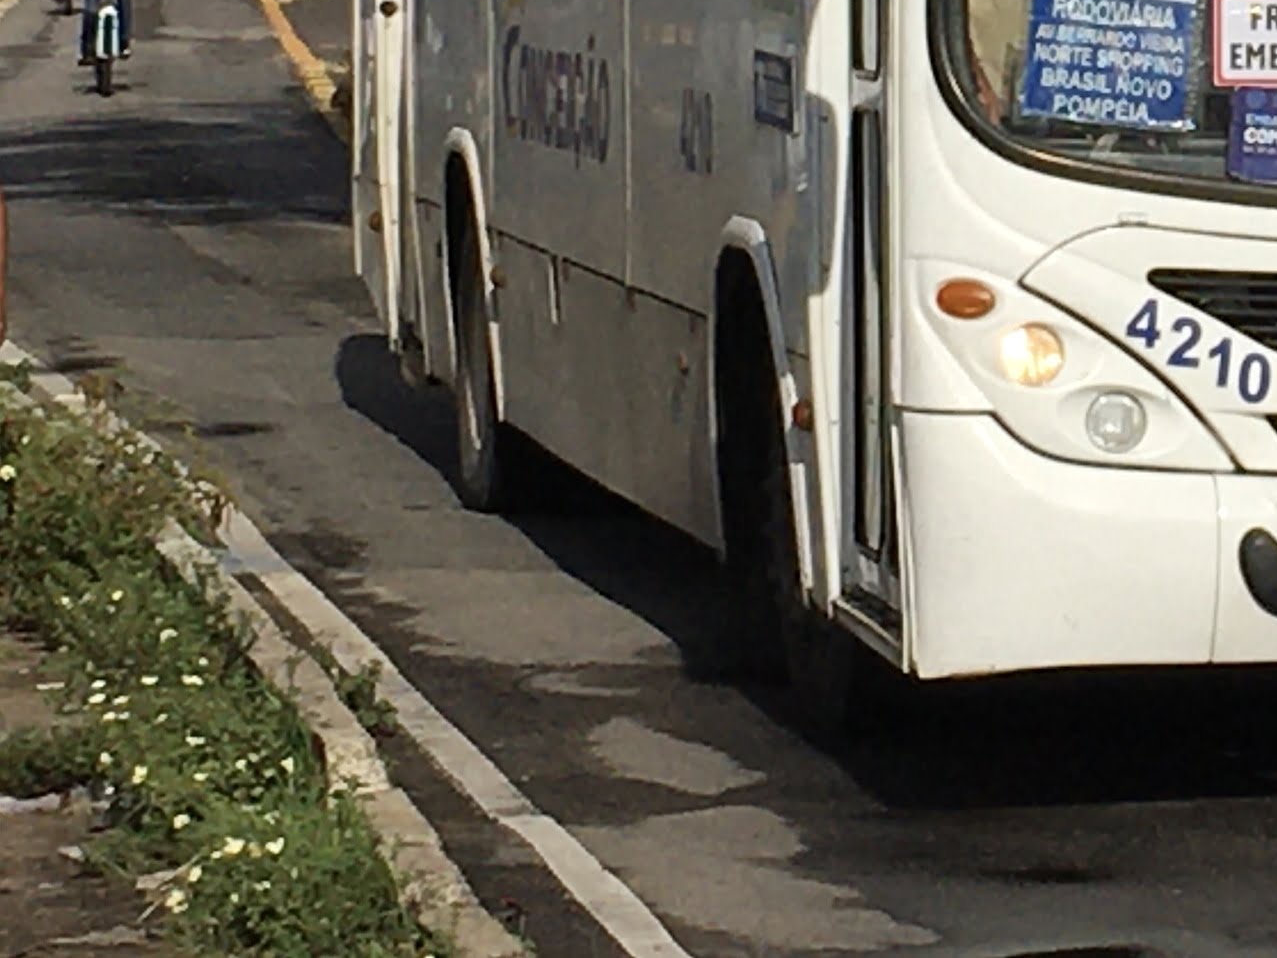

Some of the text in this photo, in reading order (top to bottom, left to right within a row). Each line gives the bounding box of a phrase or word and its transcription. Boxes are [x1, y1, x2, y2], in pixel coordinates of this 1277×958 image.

[1034, 43, 1093, 66] NORTE
[1041, 68, 1172, 100] BRASIL NOVO
[1053, 94, 1149, 121] POMPÉIA
[1126, 298, 1271, 404] 4210
